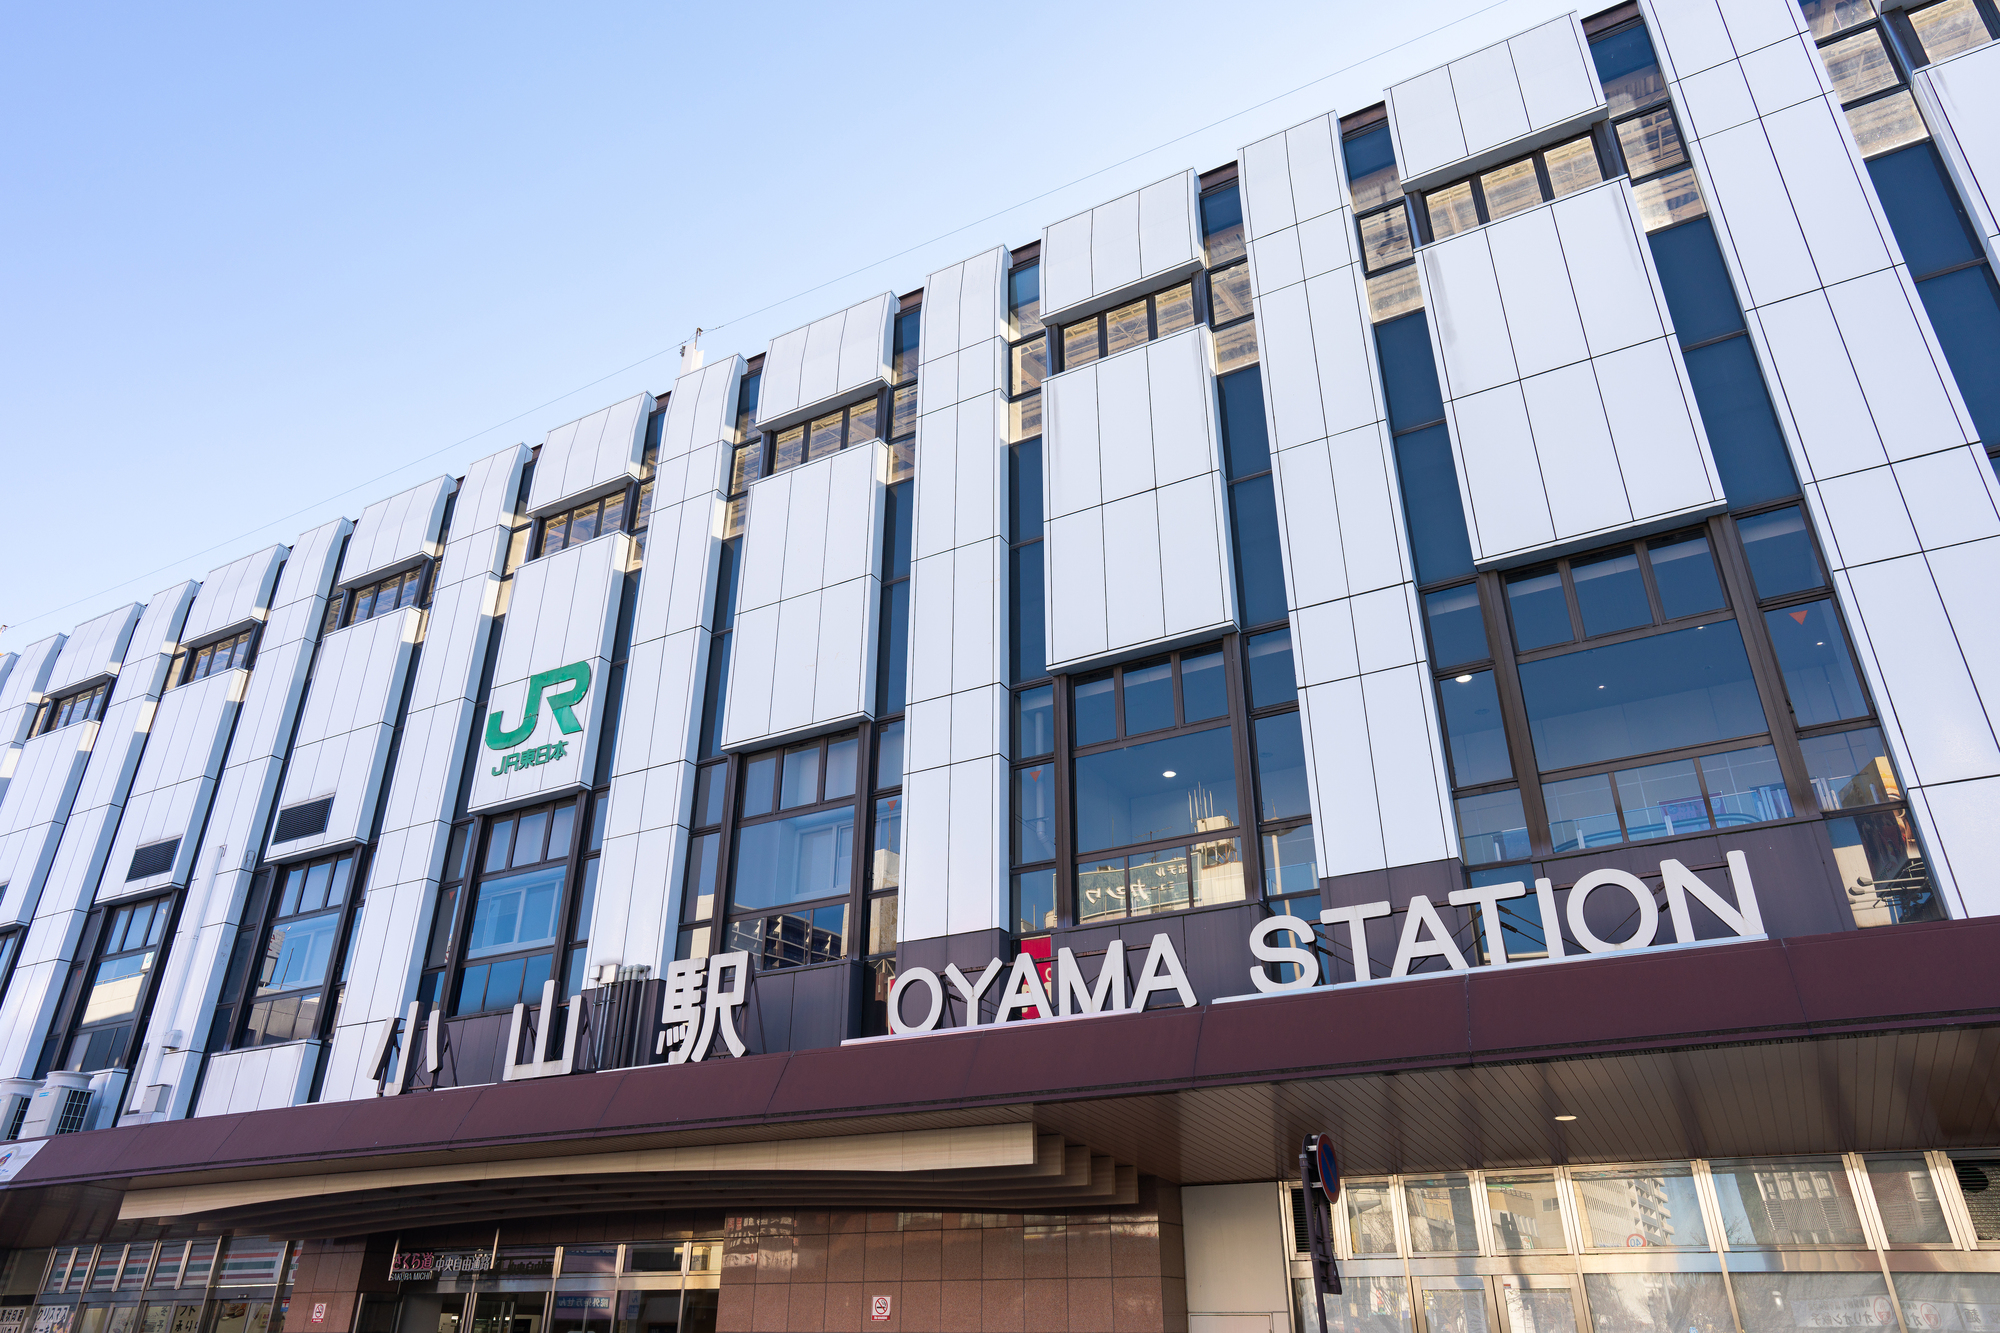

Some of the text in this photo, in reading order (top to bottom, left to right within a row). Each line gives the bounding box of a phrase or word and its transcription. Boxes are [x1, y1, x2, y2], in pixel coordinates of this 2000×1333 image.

[485, 661, 591, 750] JR
[491, 740, 569, 776] JR東日本
[888, 850, 1765, 1035] OYAMA STATION
[366, 950, 752, 1097] 小山駅
